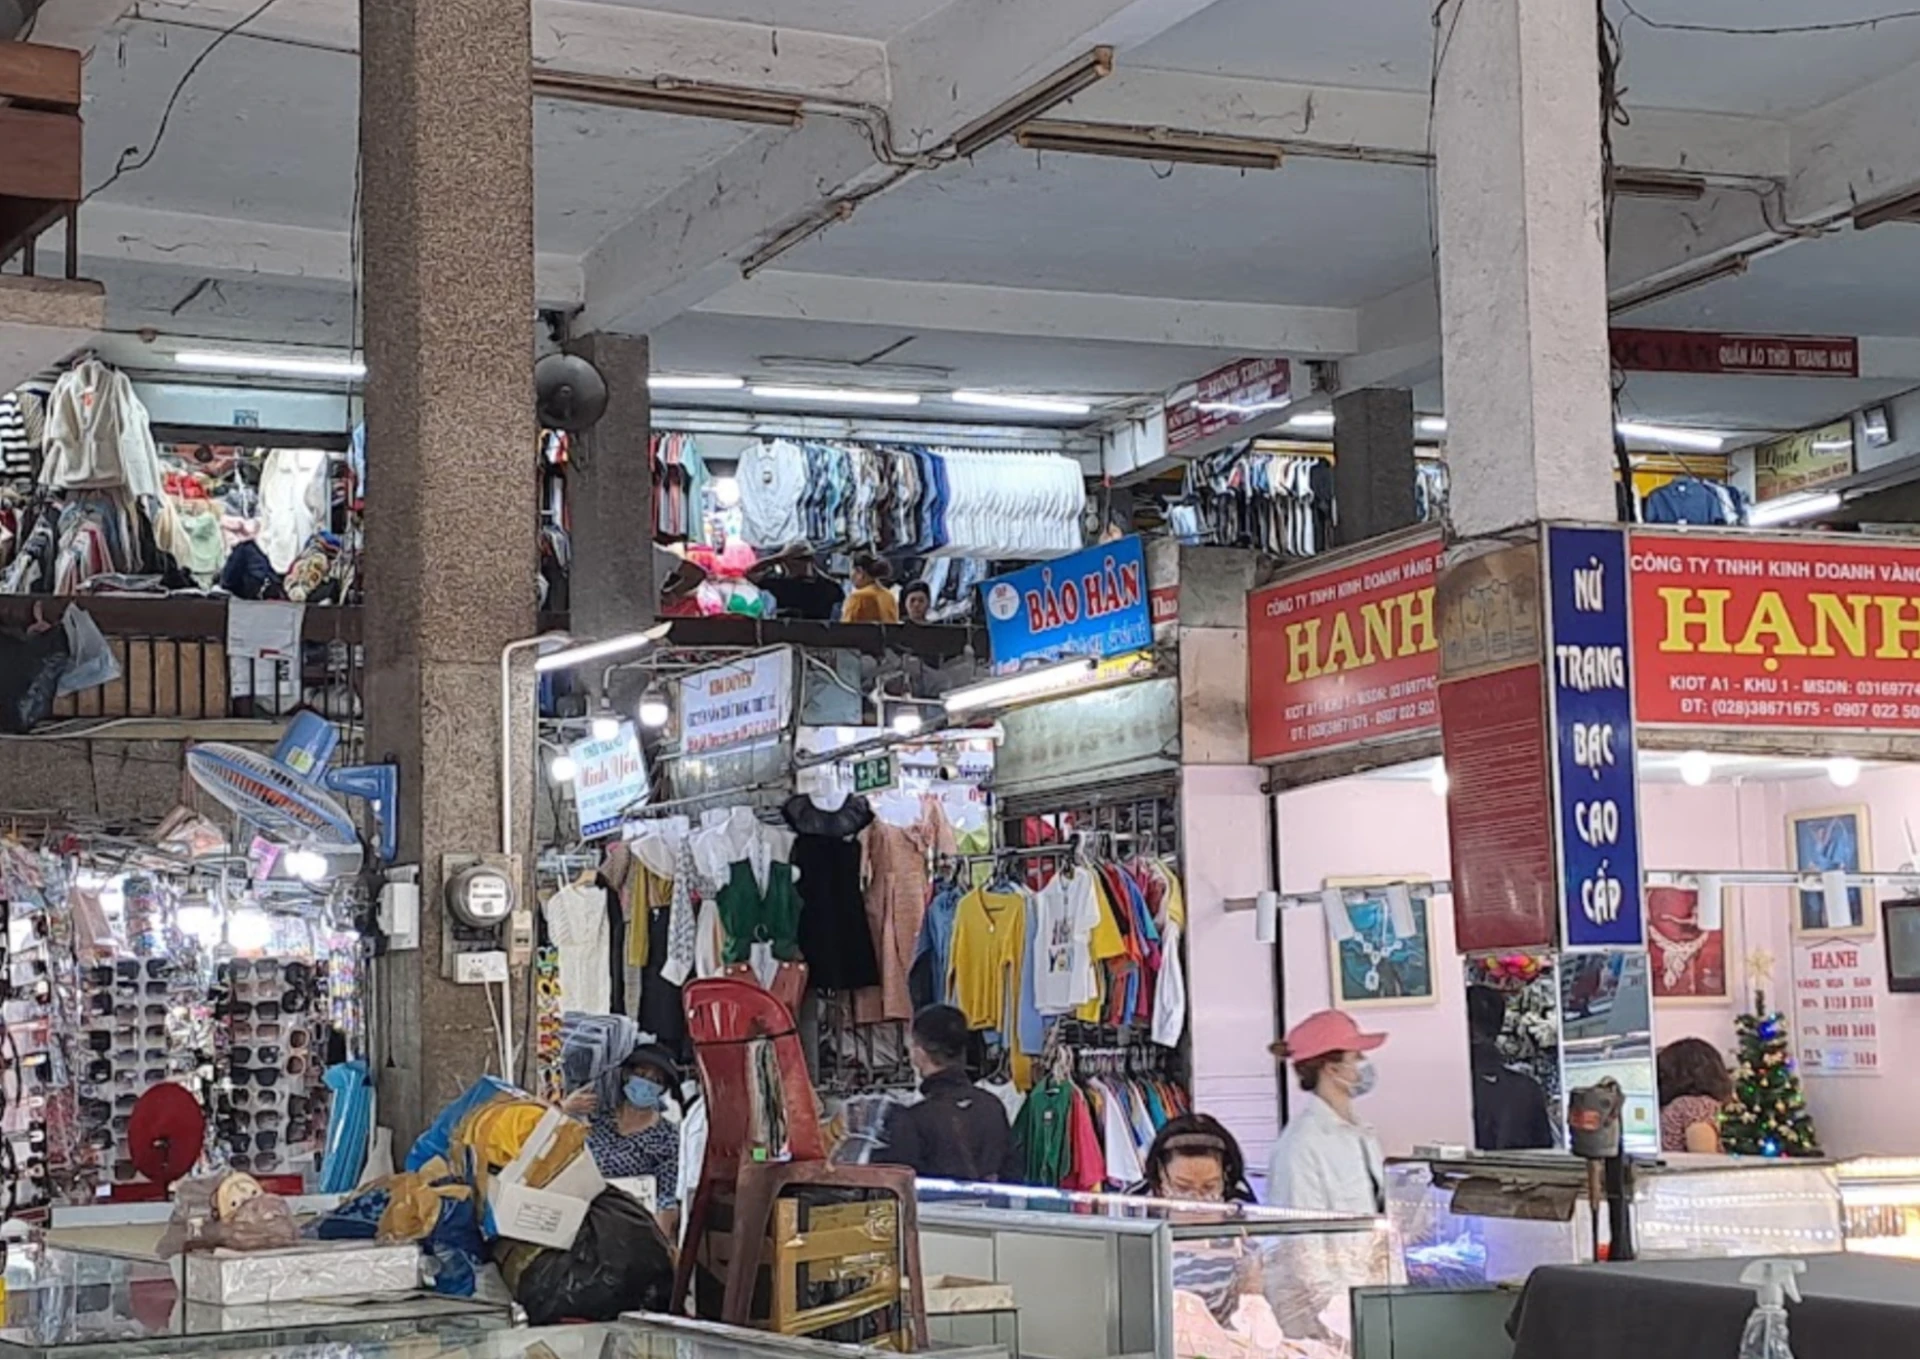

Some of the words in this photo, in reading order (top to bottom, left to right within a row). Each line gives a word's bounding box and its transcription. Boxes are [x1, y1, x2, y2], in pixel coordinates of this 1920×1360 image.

[1295, 595, 1310, 610] TY
[1338, 580, 1363, 599] KINH
[1364, 566, 1401, 590] DOANH
[1402, 557, 1433, 580] VÀNG
[1630, 551, 1682, 574] CÔNG
[1687, 557, 1711, 574] TY
[1714, 558, 1763, 576] TNHH
[1768, 560, 1811, 578] KINH
[1815, 562, 1876, 581] DOANH
[1026, 567, 1080, 634] BẢO
[1285, 587, 1439, 687] HẠNH
[1657, 586, 1920, 672] HẠNH
[1556, 645, 1626, 693] TRANG
[1669, 675, 1707, 691] KIOT
[1710, 676, 1730, 692] A1
[1743, 678, 1777, 694] KHU
[1781, 679, 1789, 694] 1
[1802, 679, 1852, 696] MSDN:
[1681, 698, 1708, 714] ĐT:
[1833, 702, 1869, 717] 0907
[1872, 703, 1899, 718] 022
[1573, 722, 1616, 781] BẠC
[1574, 799, 1619, 849] CAO
[1580, 859, 1623, 927] CẤP
